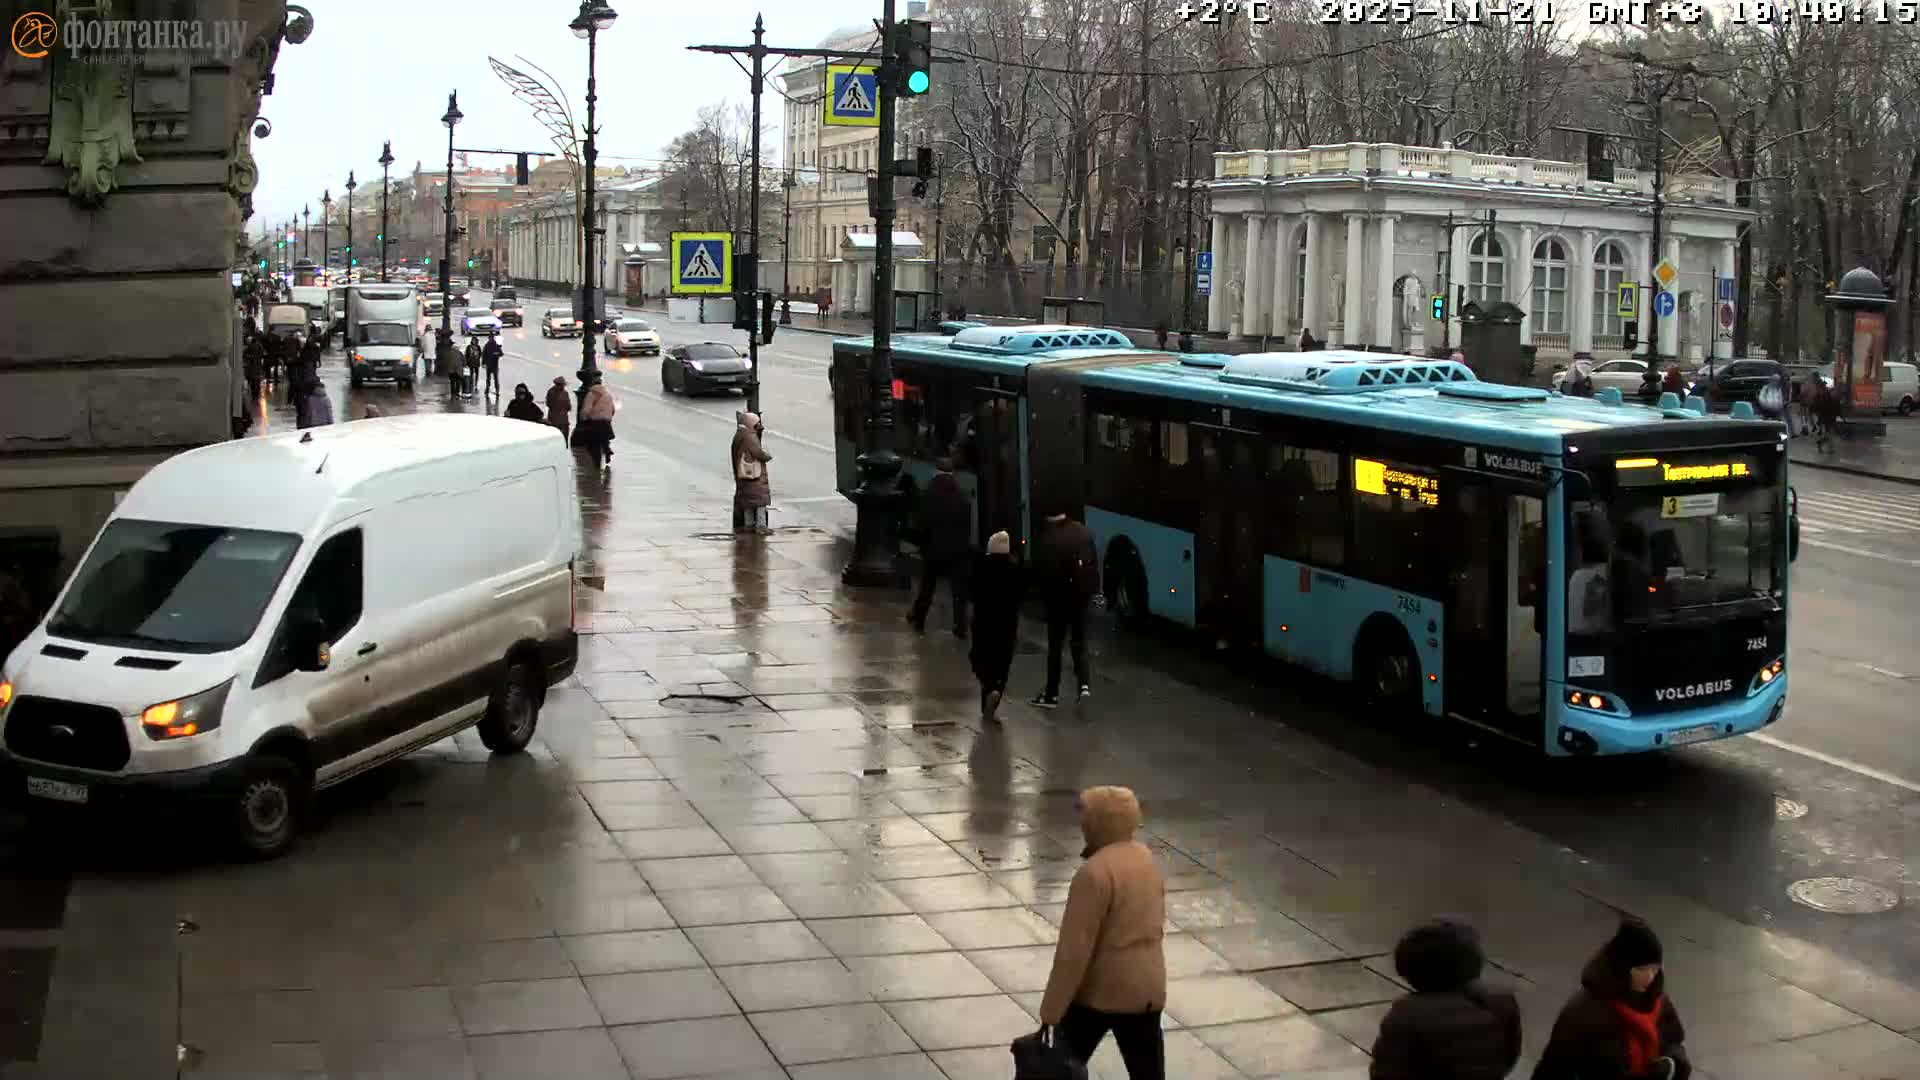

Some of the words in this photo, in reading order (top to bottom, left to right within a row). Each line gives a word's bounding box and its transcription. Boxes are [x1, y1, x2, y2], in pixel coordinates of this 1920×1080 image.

[1667, 497, 1677, 515] 3
[1746, 638, 1768, 651] 7454
[1655, 678, 1733, 702] VOLGABUS
